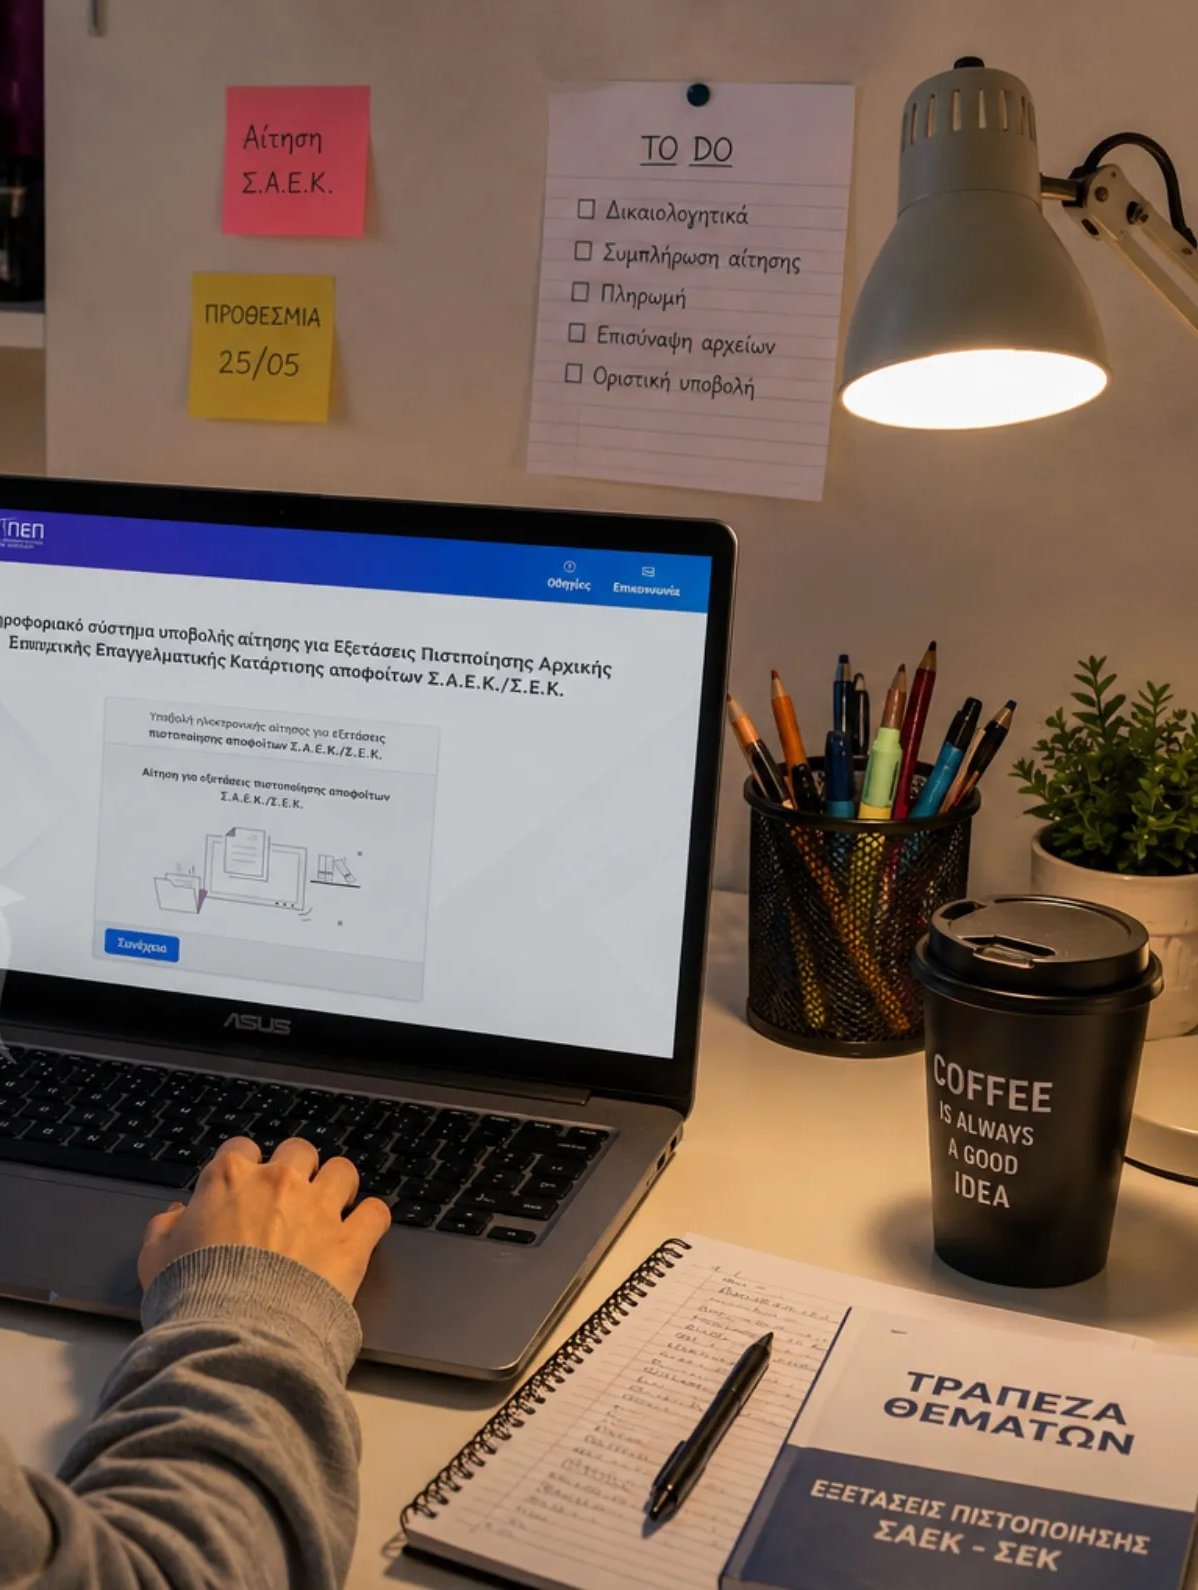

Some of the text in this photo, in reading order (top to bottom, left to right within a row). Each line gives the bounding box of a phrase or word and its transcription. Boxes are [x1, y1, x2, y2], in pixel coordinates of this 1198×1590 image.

[243, 124, 322, 154] Αίτηση
[641, 135, 733, 163] TO DO
[242, 171, 333, 194] Σ.Α.Ε.Κ.
[606, 200, 749, 229] Δικαιολογητικά
[603, 242, 801, 274] Συμπλήρωση αίτησης
[602, 284, 687, 310] Πληρωμή
[205, 304, 321, 328] ΠΡΟΘΕΣΜΙΑ
[597, 325, 776, 357] Επισύναψη αρχείων
[219, 346, 300, 381] 25/05
[593, 365, 755, 400] Οριστική υποβολή
[88, 620, 154, 640] σύστημα
[159, 626, 234, 647] υποβολής
[238, 632, 300, 652] αίτησης
[304, 640, 329, 654] για
[334, 640, 416, 663] Εξετάσεις
[539, 657, 612, 680] Αρχικής
[96, 643, 226, 669] Επαγγελματικής
[230, 654, 324, 678] Κατάρτισης
[329, 666, 423, 684] αποφοίτων
[428, 671, 564, 697] Σ.Α.Ε.Κ./Σ.Ε.Κ.
[329, 787, 391, 801] αποφοίτων
[223, 1013, 292, 1035] ASUS
[933, 1054, 1053, 1113] COFFEE
[939, 1100, 1034, 1146] IS ALWAYS
[948, 1137, 1018, 1176] A GOOD
[955, 1171, 1011, 1209] IDEA
[907, 1371, 1127, 1426] ΤΡΑΠΕΖΑ
[883, 1397, 1135, 1456] ΘΕΜΑΤΩΝ
[810, 1479, 1151, 1556] ΕΞΕΤΑΣΕΙΣ ΠΙΣΤΟΠΟΙΗΣΗΣ
[873, 1520, 966, 1555] ΣΑΕΚ
[993, 1540, 1063, 1572] ΣΕΚ
